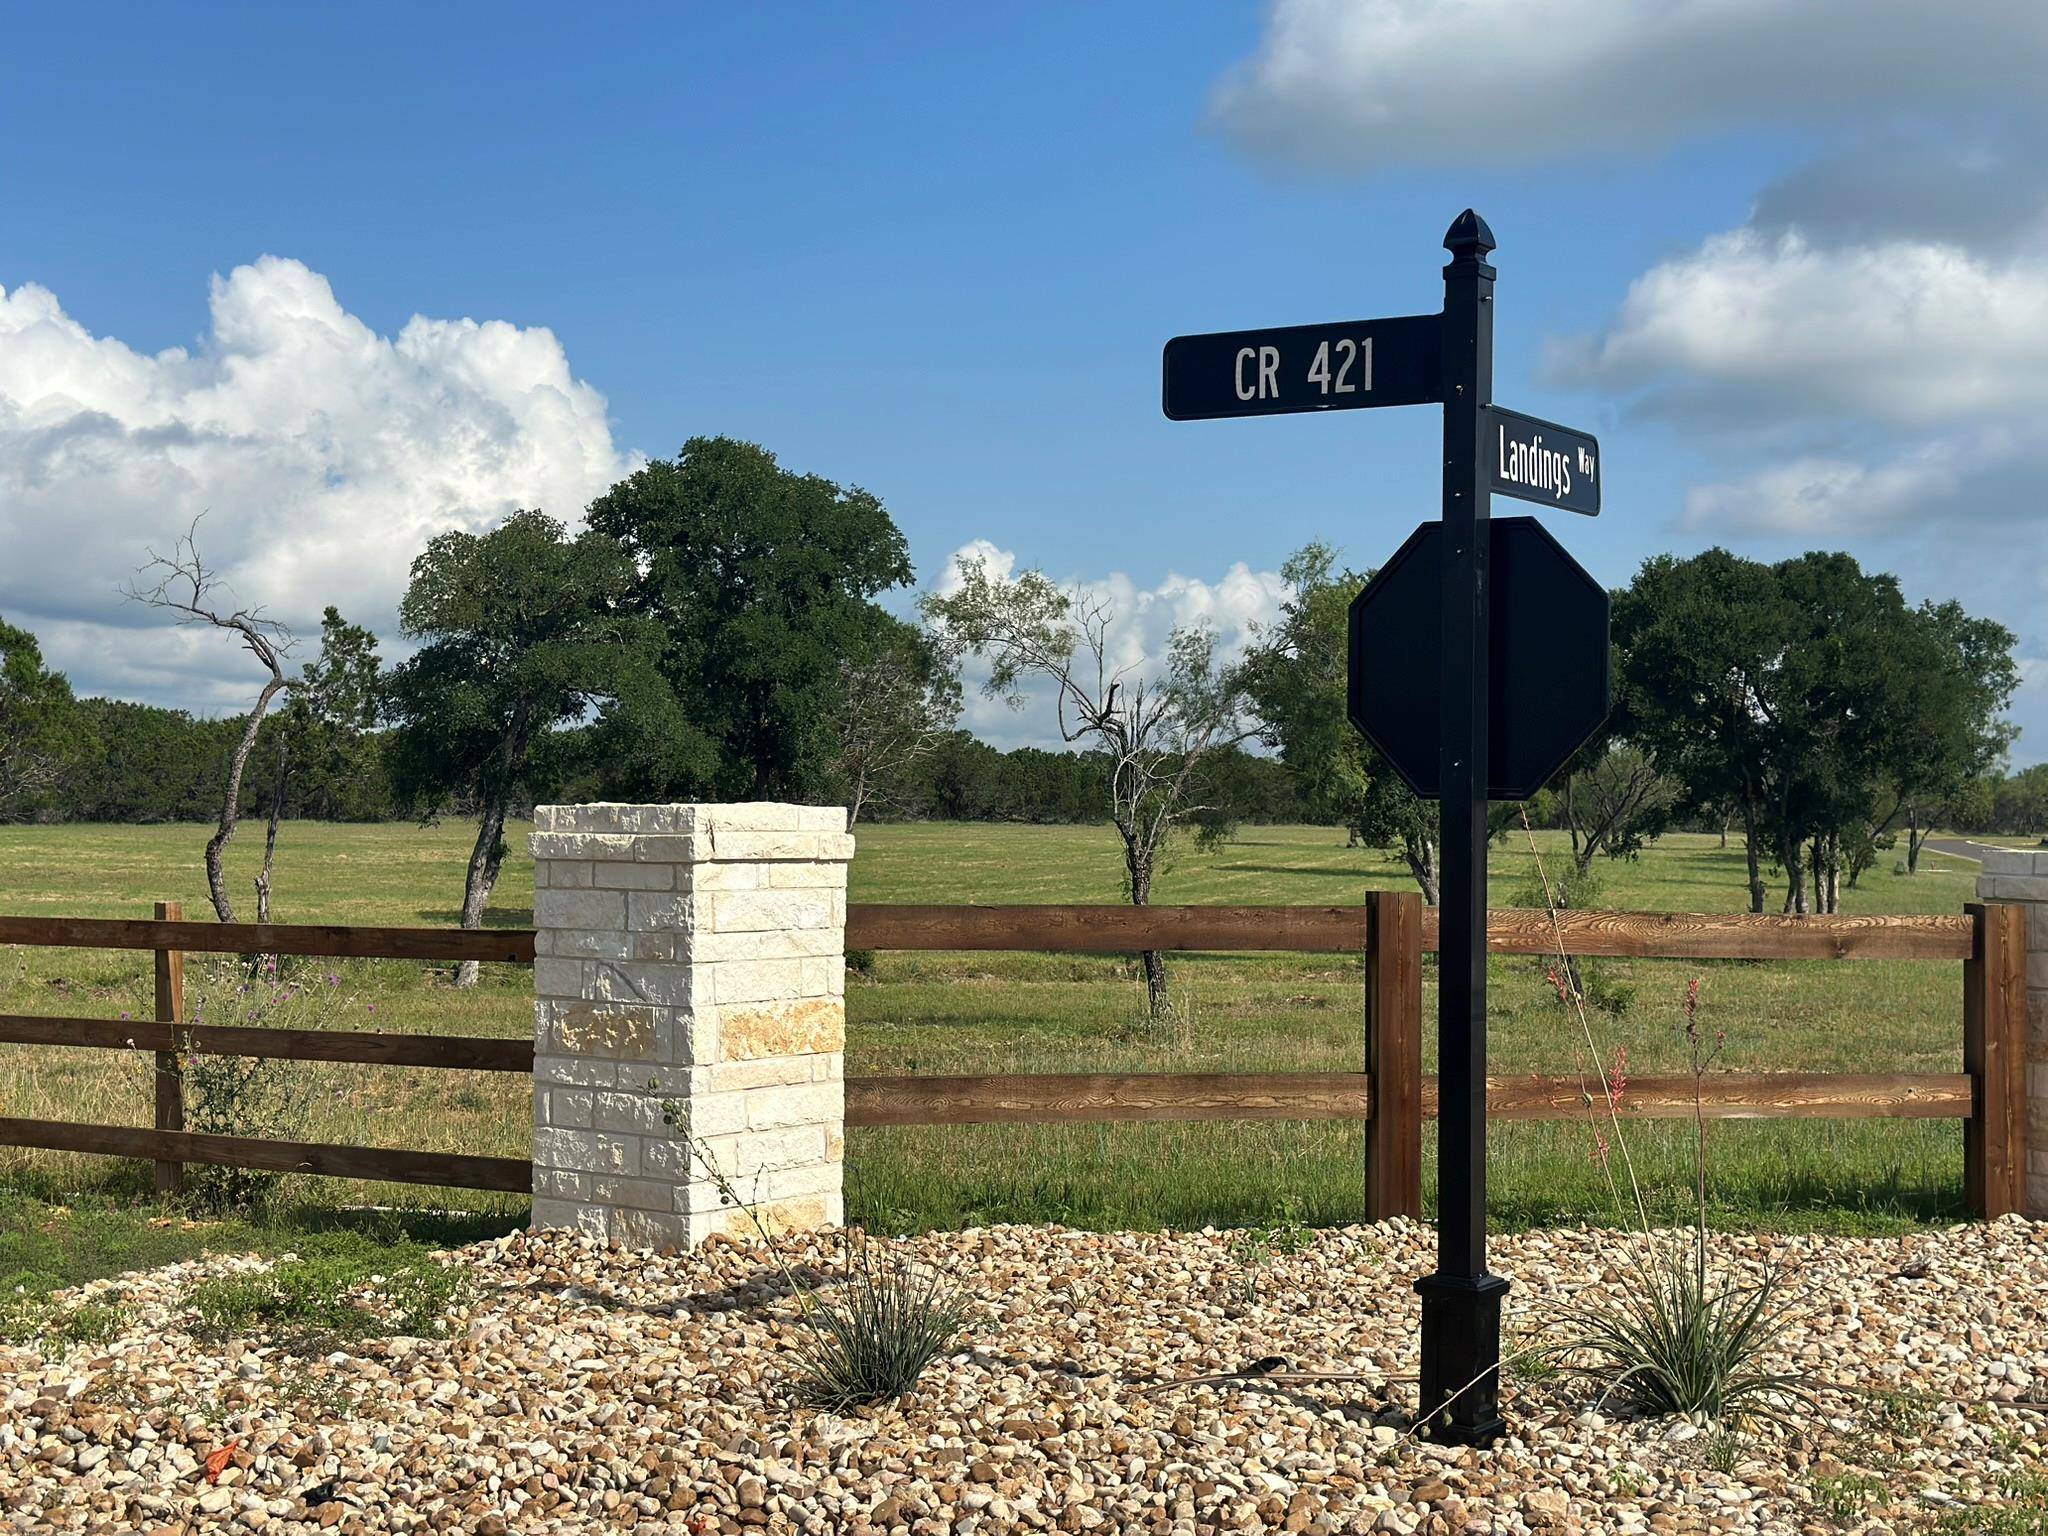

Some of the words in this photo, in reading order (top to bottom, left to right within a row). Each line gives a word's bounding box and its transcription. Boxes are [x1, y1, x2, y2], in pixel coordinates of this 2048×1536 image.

[1234, 345, 1281, 401] CR
[1306, 337, 1373, 395] 421
[1499, 424, 1571, 500] Landings
[1577, 446, 1595, 483] Way
